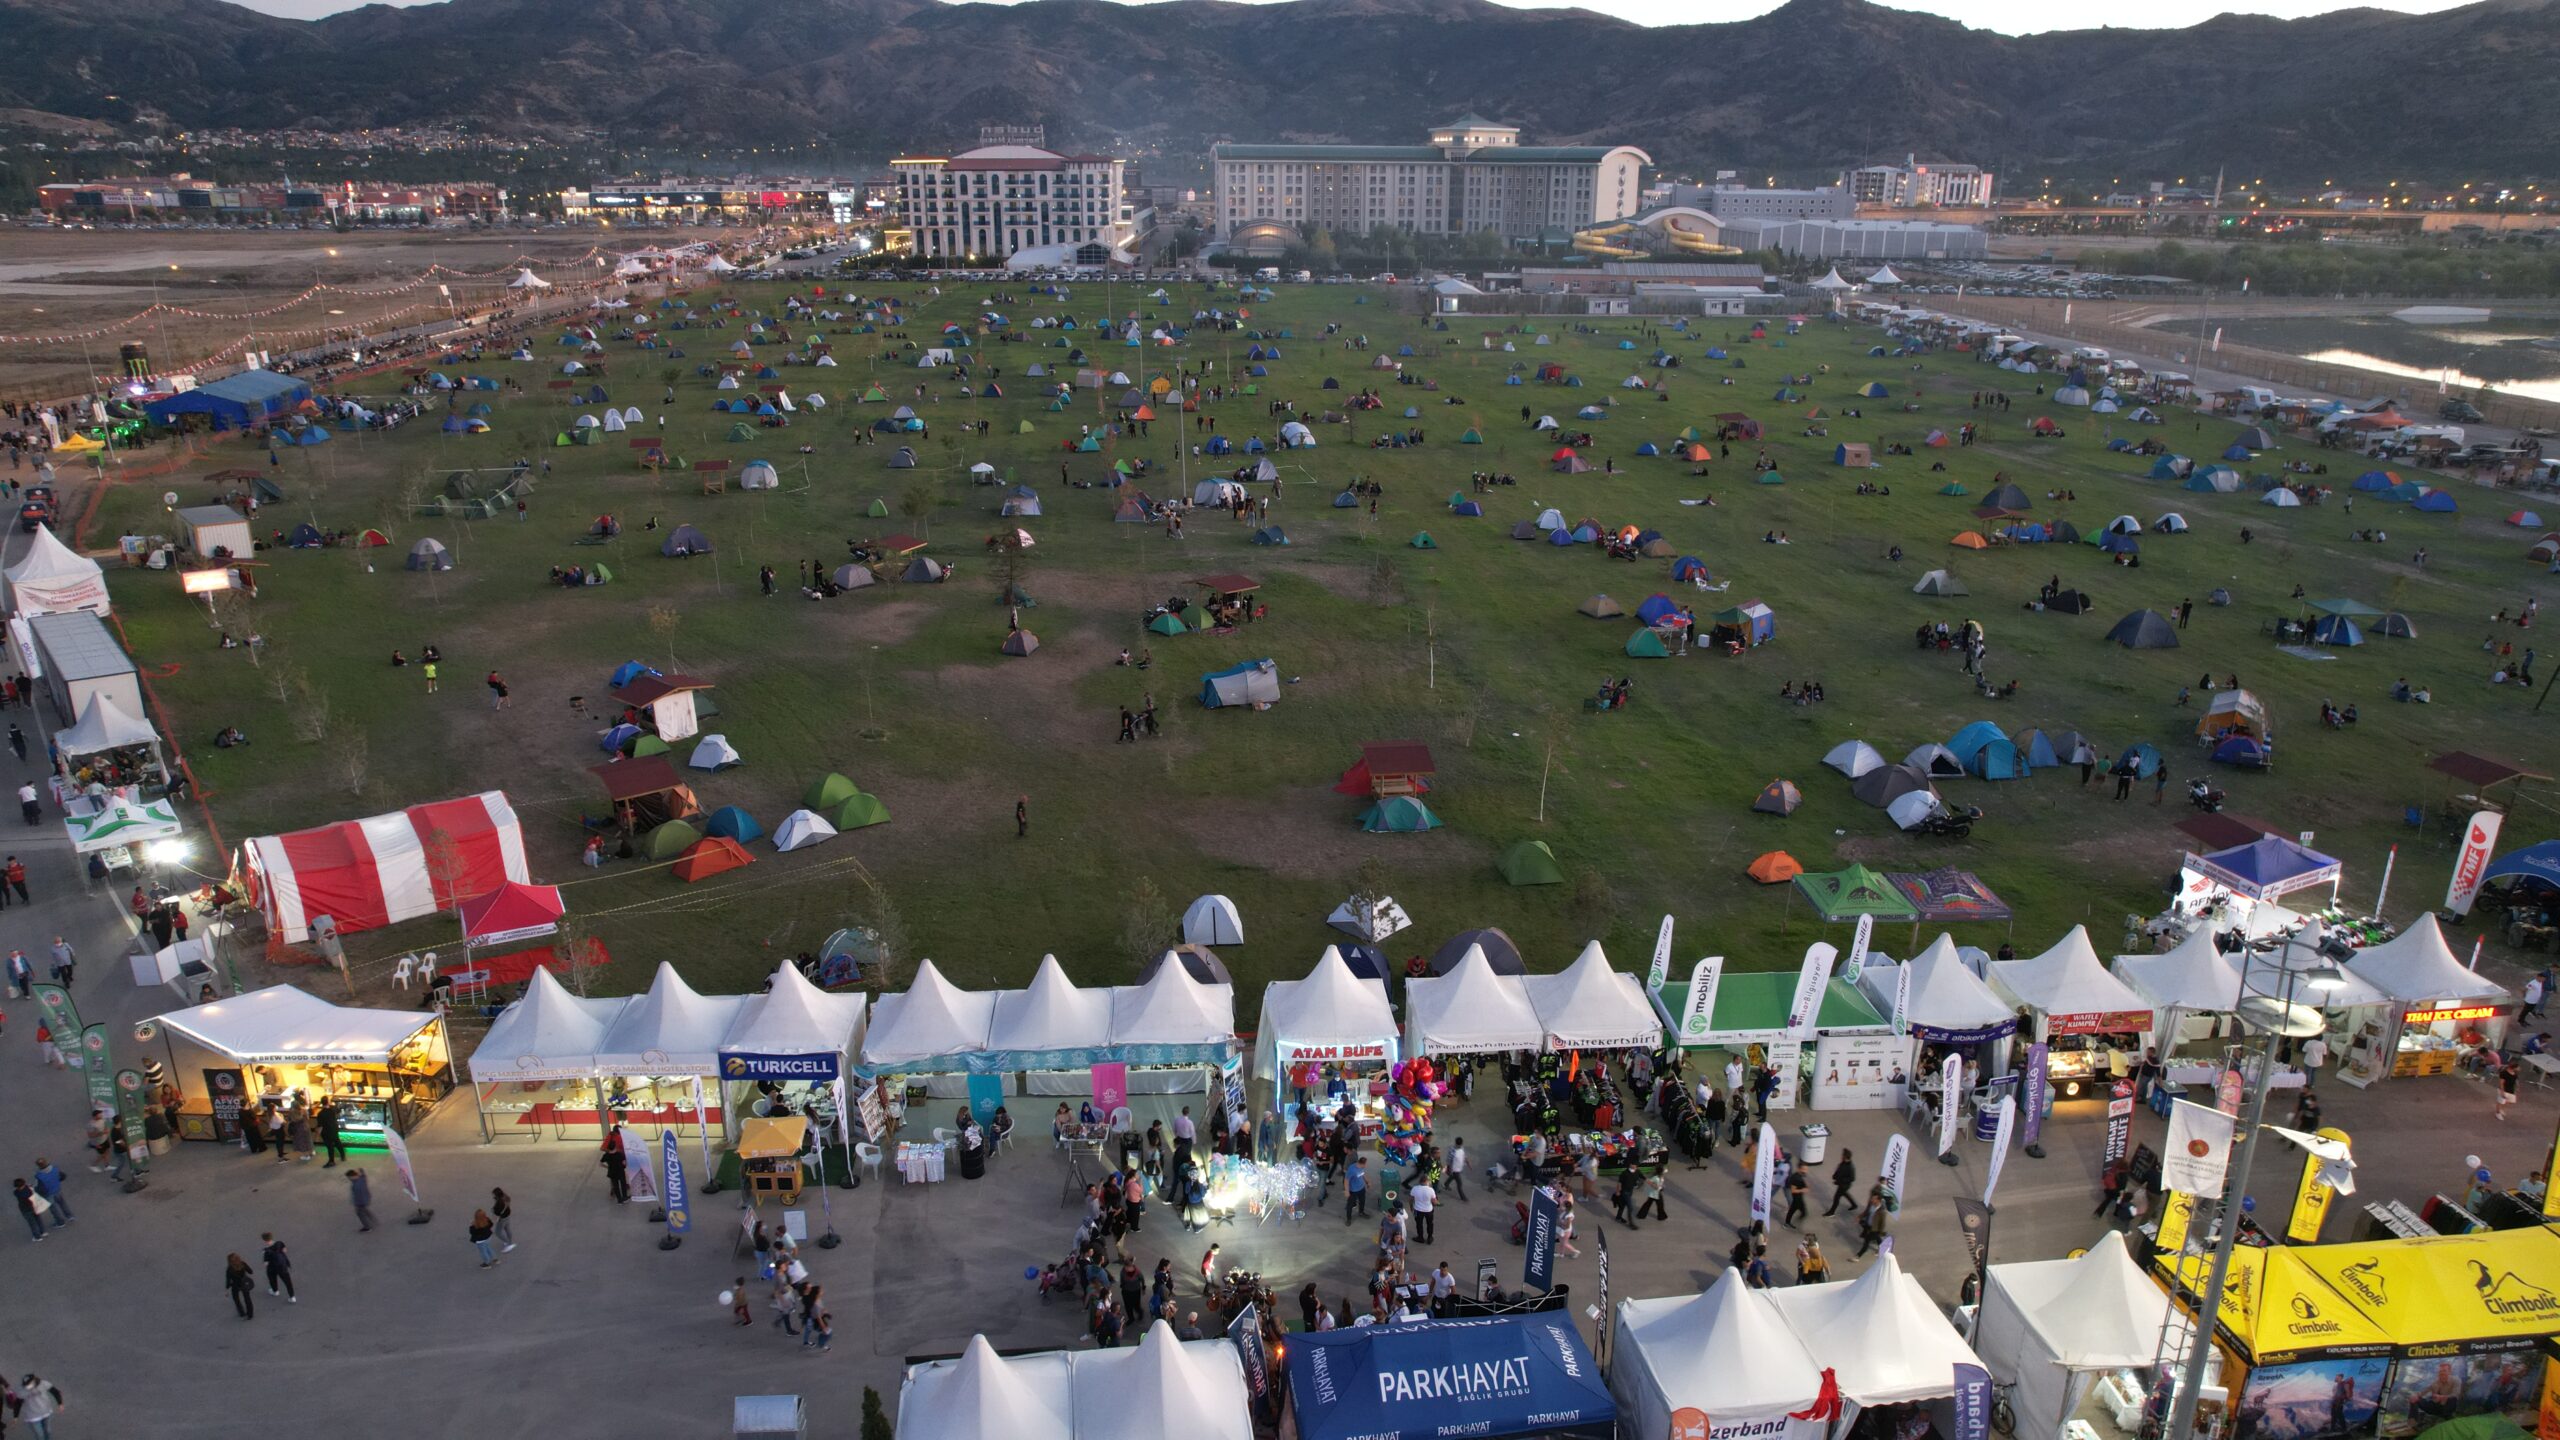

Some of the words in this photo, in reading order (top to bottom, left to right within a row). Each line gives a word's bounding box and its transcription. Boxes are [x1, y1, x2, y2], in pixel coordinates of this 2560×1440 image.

[2463, 847, 2480, 880] TMF
[1696, 966, 1712, 1013] mobiliz
[2073, 1013, 2100, 1021] WAFFLE
[2406, 1012, 2433, 1022] THAI
[2433, 1010, 2453, 1020] ICE
[2453, 1007, 2494, 1019] CREAM
[2067, 1019, 2097, 1028] KUMPİR
[1292, 1047, 1337, 1058] ATAM
[497, 1069, 532, 1077] MARBLE
[533, 1068, 561, 1076] HOTEL
[561, 1067, 588, 1075] STORE
[685, 1064, 712, 1072] STORE
[747, 1060, 832, 1073] TURKCELL
[667, 1138, 682, 1208] TURKCELL
[1531, 1209, 1549, 1276] PARKHAYAT
[2340, 1267, 2386, 1308] Climbolic
[2484, 1293, 2560, 1315] Climbolic
[2288, 1321, 2342, 1336] Climbolic
[1546, 1325, 1582, 1377] PARKHAYAT
[2408, 1343, 2460, 1357] Climbolic
[2470, 1343, 2487, 1351] Feel
[2488, 1343, 2505, 1351] your
[2506, 1339, 2534, 1348] Breath
[1311, 1347, 1337, 1404] PARKHAYAT
[1379, 1356, 1529, 1402] PARKHAYAT
[1457, 1392, 1493, 1403] SAĞLIK
[1498, 1387, 1531, 1398] GRUBU
[1528, 1409, 1580, 1425] PARKHAYAT
[1437, 1421, 1491, 1437] PARKHAYAT
[1710, 1416, 1787, 1440] zerband
